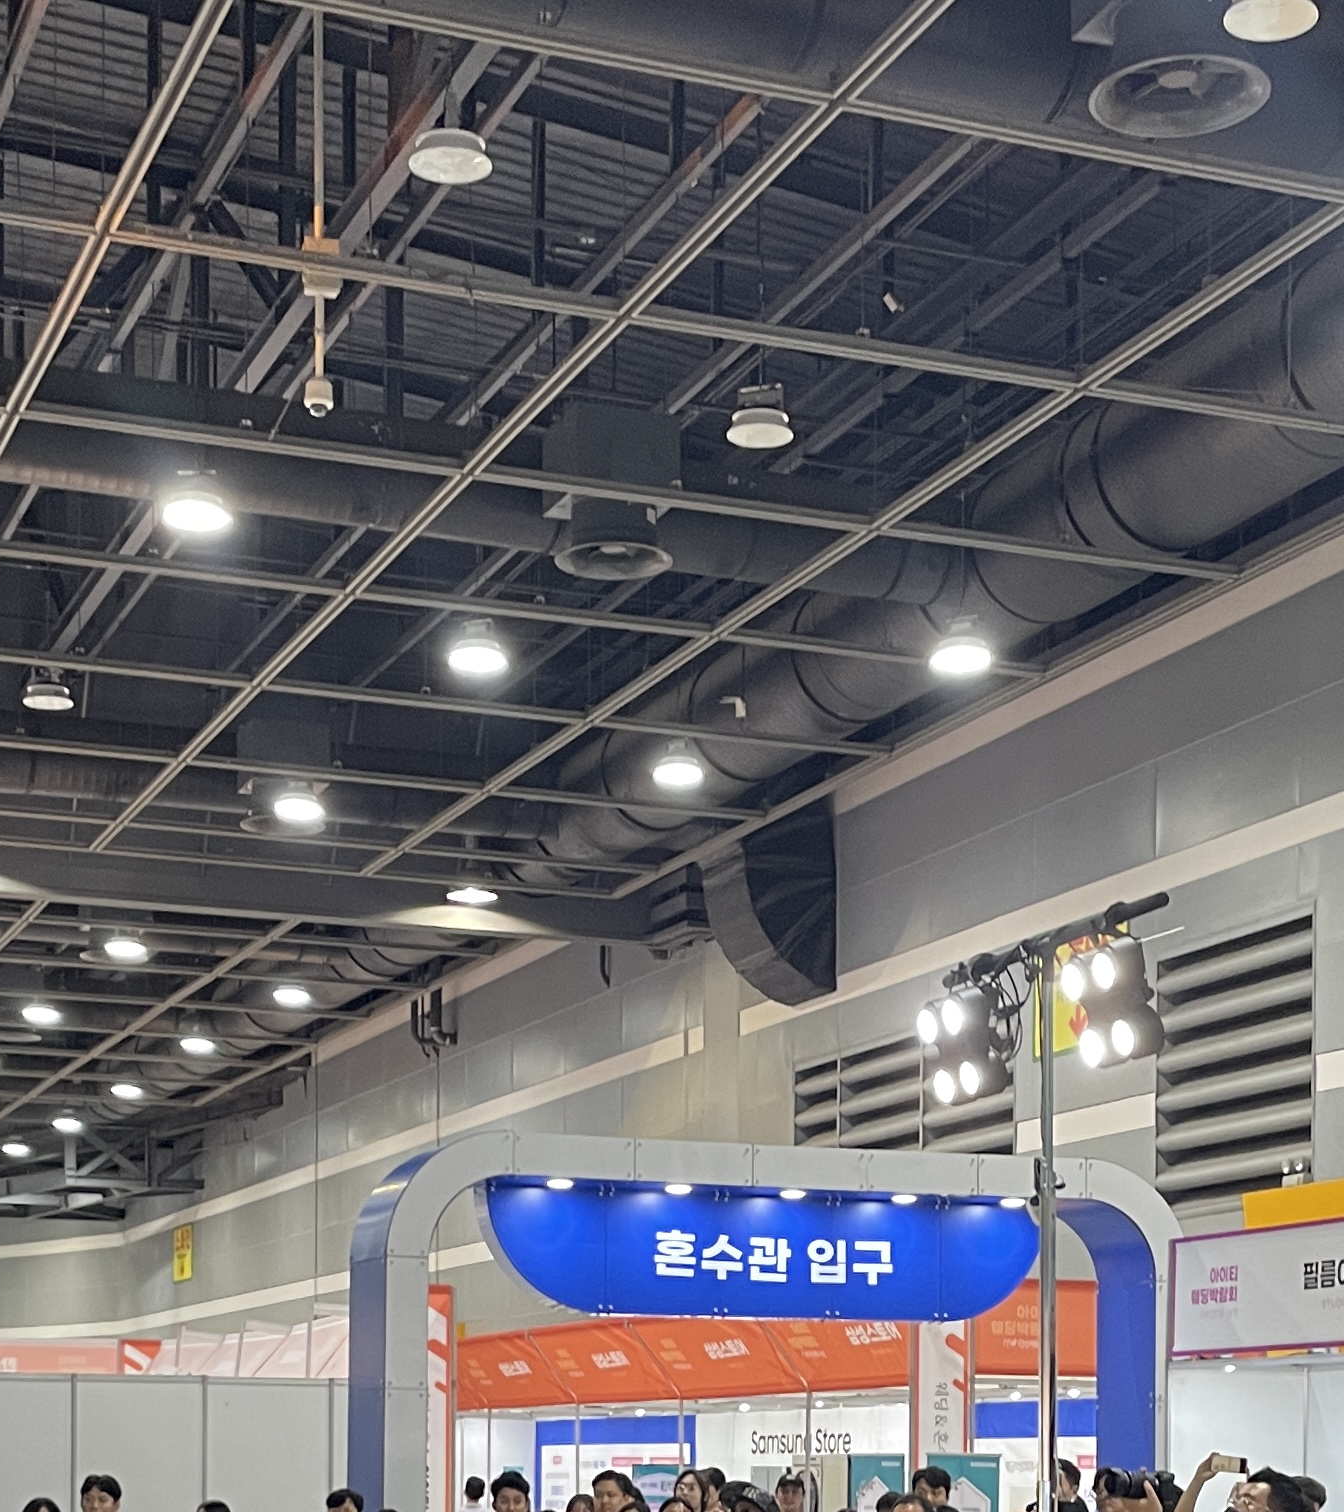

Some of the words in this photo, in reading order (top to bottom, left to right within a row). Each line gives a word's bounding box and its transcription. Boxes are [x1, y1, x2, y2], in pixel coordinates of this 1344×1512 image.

[654, 1229, 792, 1283] 혼수관
[807, 1239, 893, 1286] 입구
[1210, 1265, 1239, 1283] 아이티
[751, 1430, 811, 1454] Samsun
[815, 1428, 852, 1454] Store
